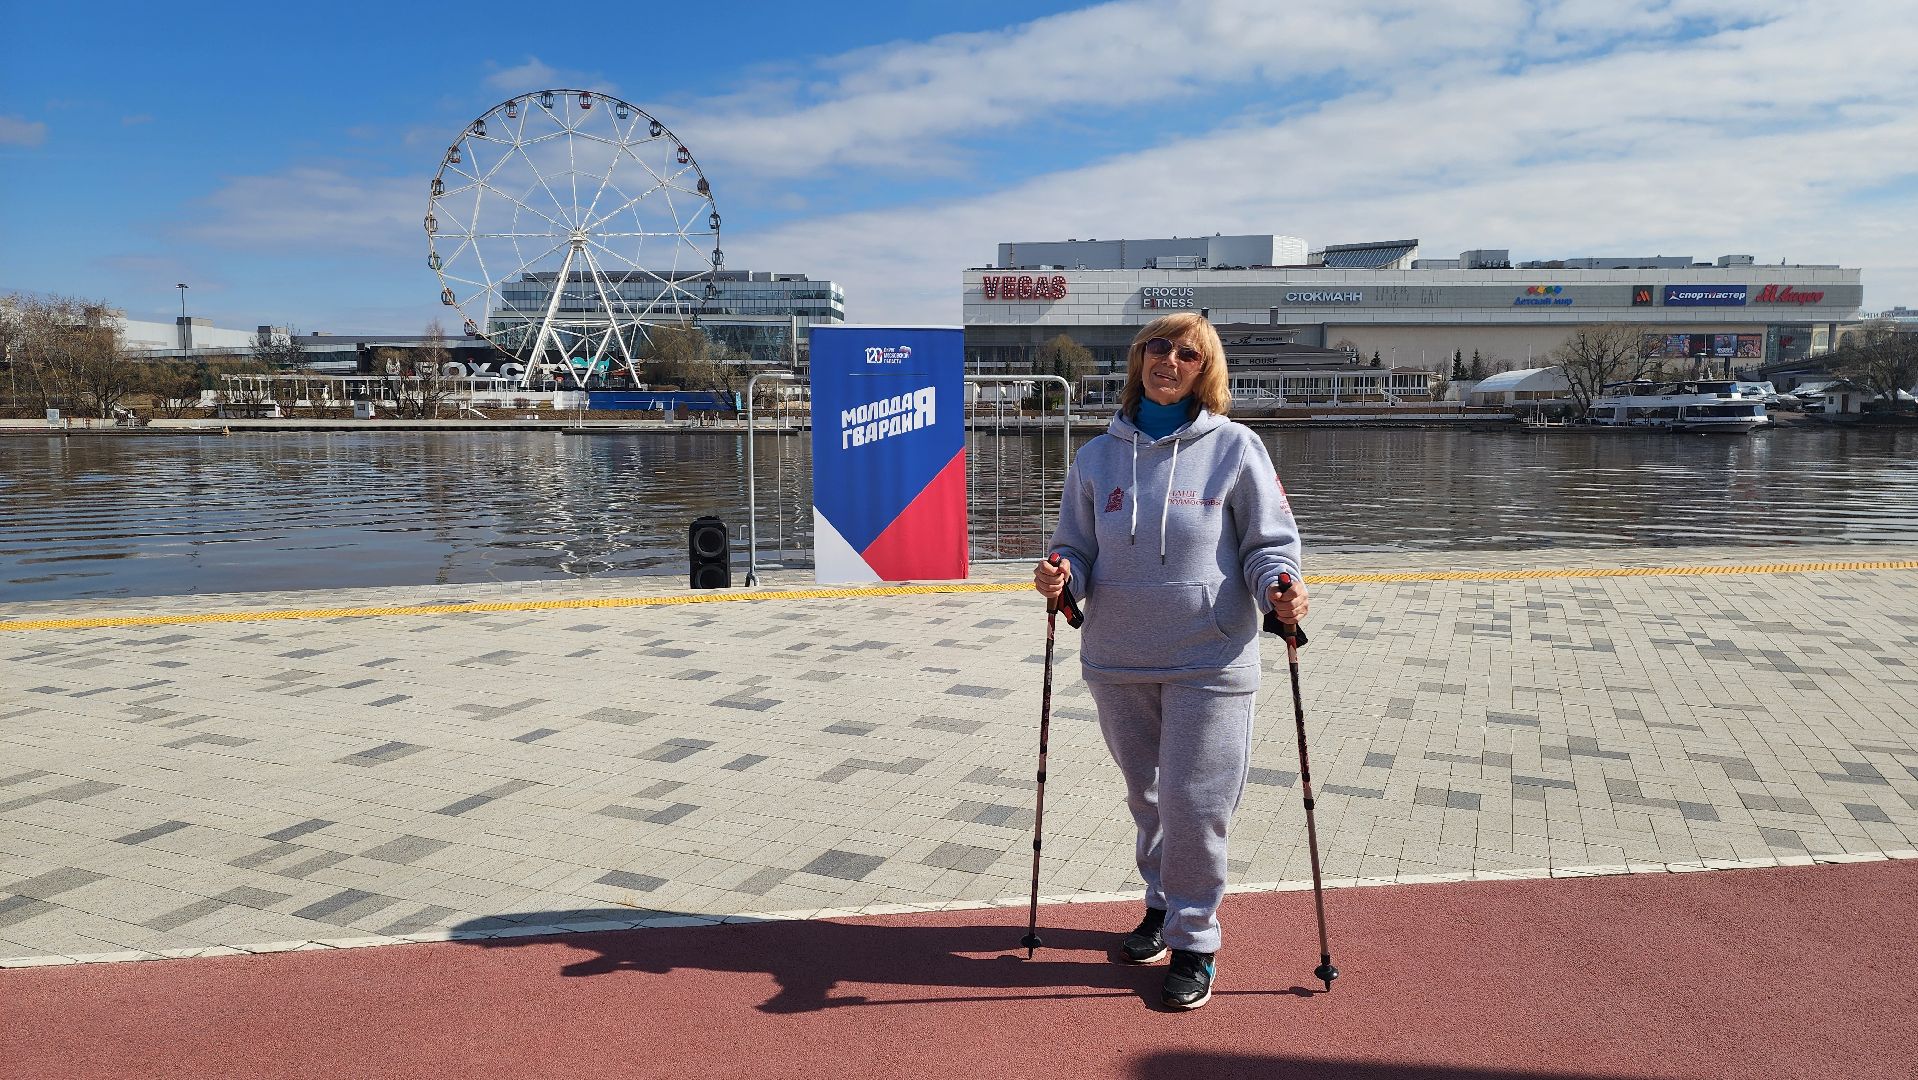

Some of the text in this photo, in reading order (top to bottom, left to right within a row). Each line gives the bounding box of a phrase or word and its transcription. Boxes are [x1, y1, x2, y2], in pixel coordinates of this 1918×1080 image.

[983, 275, 1067, 300] VEGAS
[1143, 287, 1194, 297] CROCUS
[1286, 291, 1363, 302] СТОКМАНН
[1514, 297, 1573, 307] Детский мир
[842, 386, 936, 429] МОЛОДАЯ
[842, 386, 936, 450] ГВАРДИЯ
